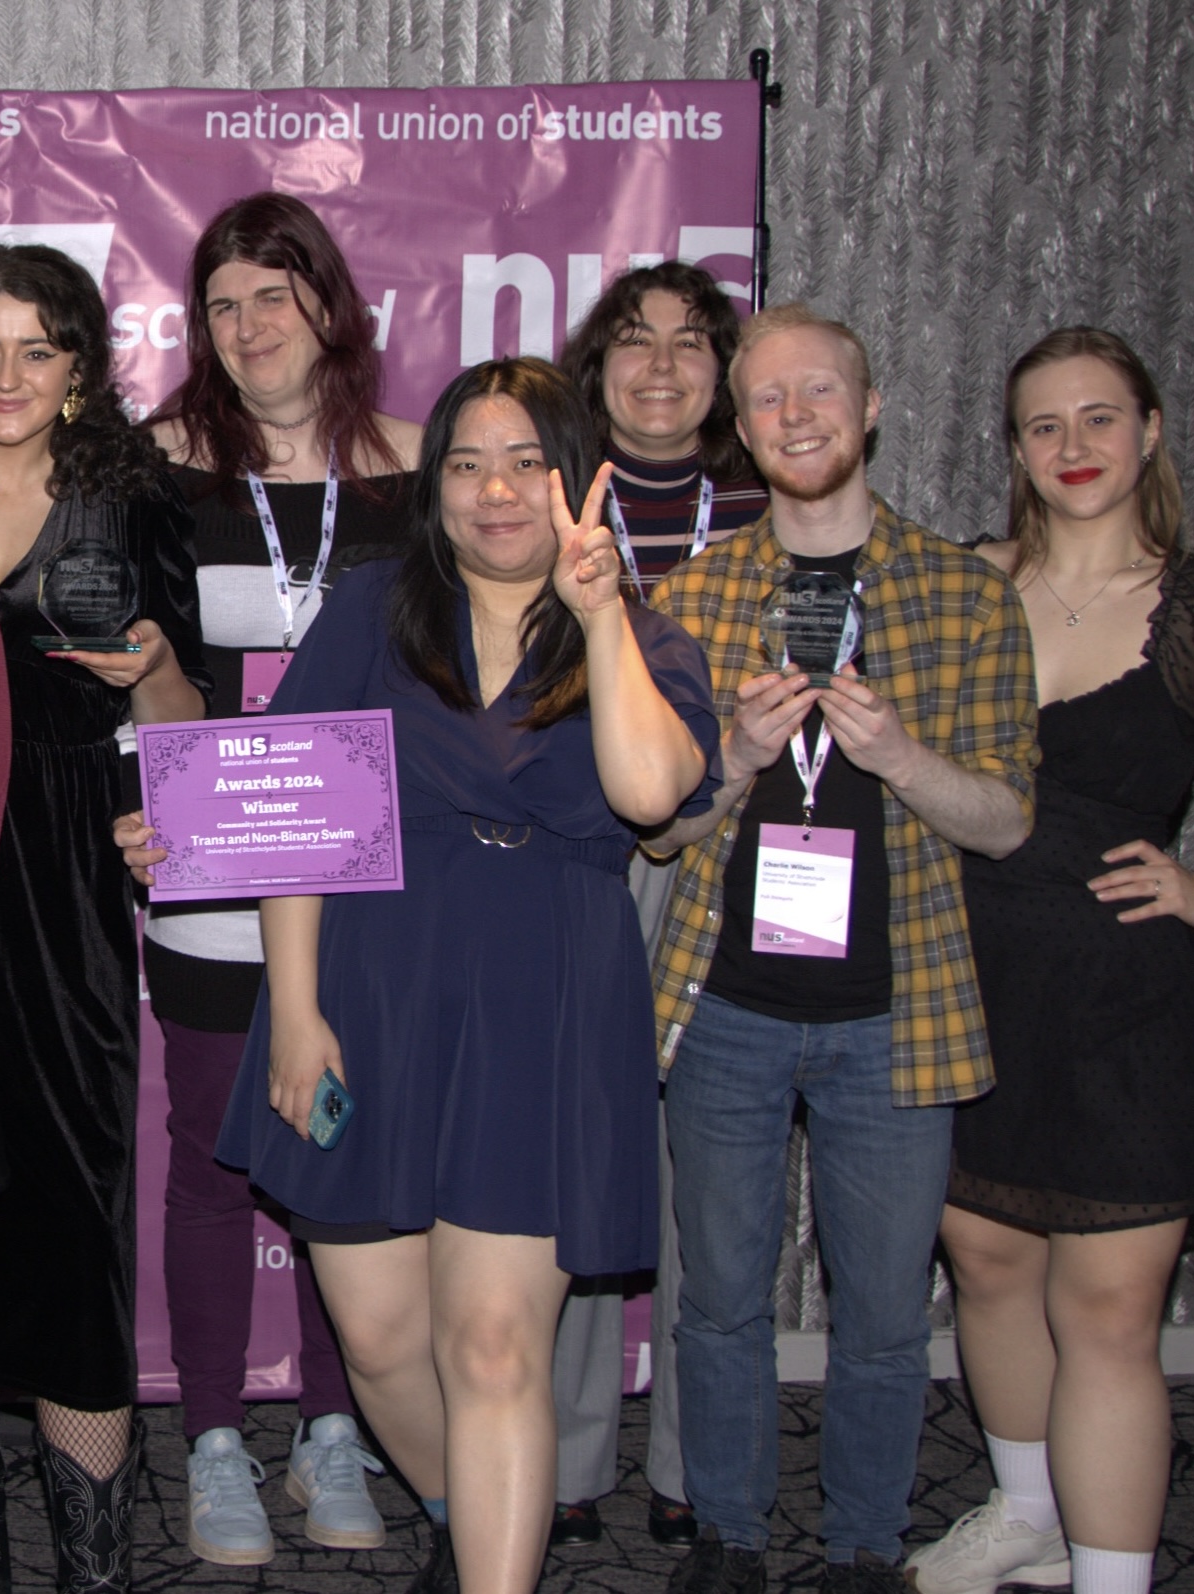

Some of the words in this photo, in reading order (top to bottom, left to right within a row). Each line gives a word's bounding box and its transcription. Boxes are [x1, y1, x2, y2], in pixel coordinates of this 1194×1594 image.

[205, 102, 364, 140] national
[377, 103, 484, 140] union
[496, 103, 535, 140] of
[542, 102, 723, 141] students
[60, 560, 92, 572] nus
[780, 591, 812, 605] nus
[218, 737, 267, 757] nus
[270, 739, 313, 752] scotland
[220, 759, 244, 767] national
[213, 774, 281, 792] Awards
[283, 775, 324, 788] 2024
[241, 800, 299, 815] Winner
[216, 821, 255, 829] Community
[269, 818, 302, 827] Solidarity
[303, 817, 326, 825] Award
[190, 835, 226, 846] Trans
[227, 832, 250, 845] and
[251, 830, 320, 843] Non-Binary
[321, 827, 355, 840] Swim
[242, 845, 277, 853] Strathclyde
[760, 933, 782, 942] nus
